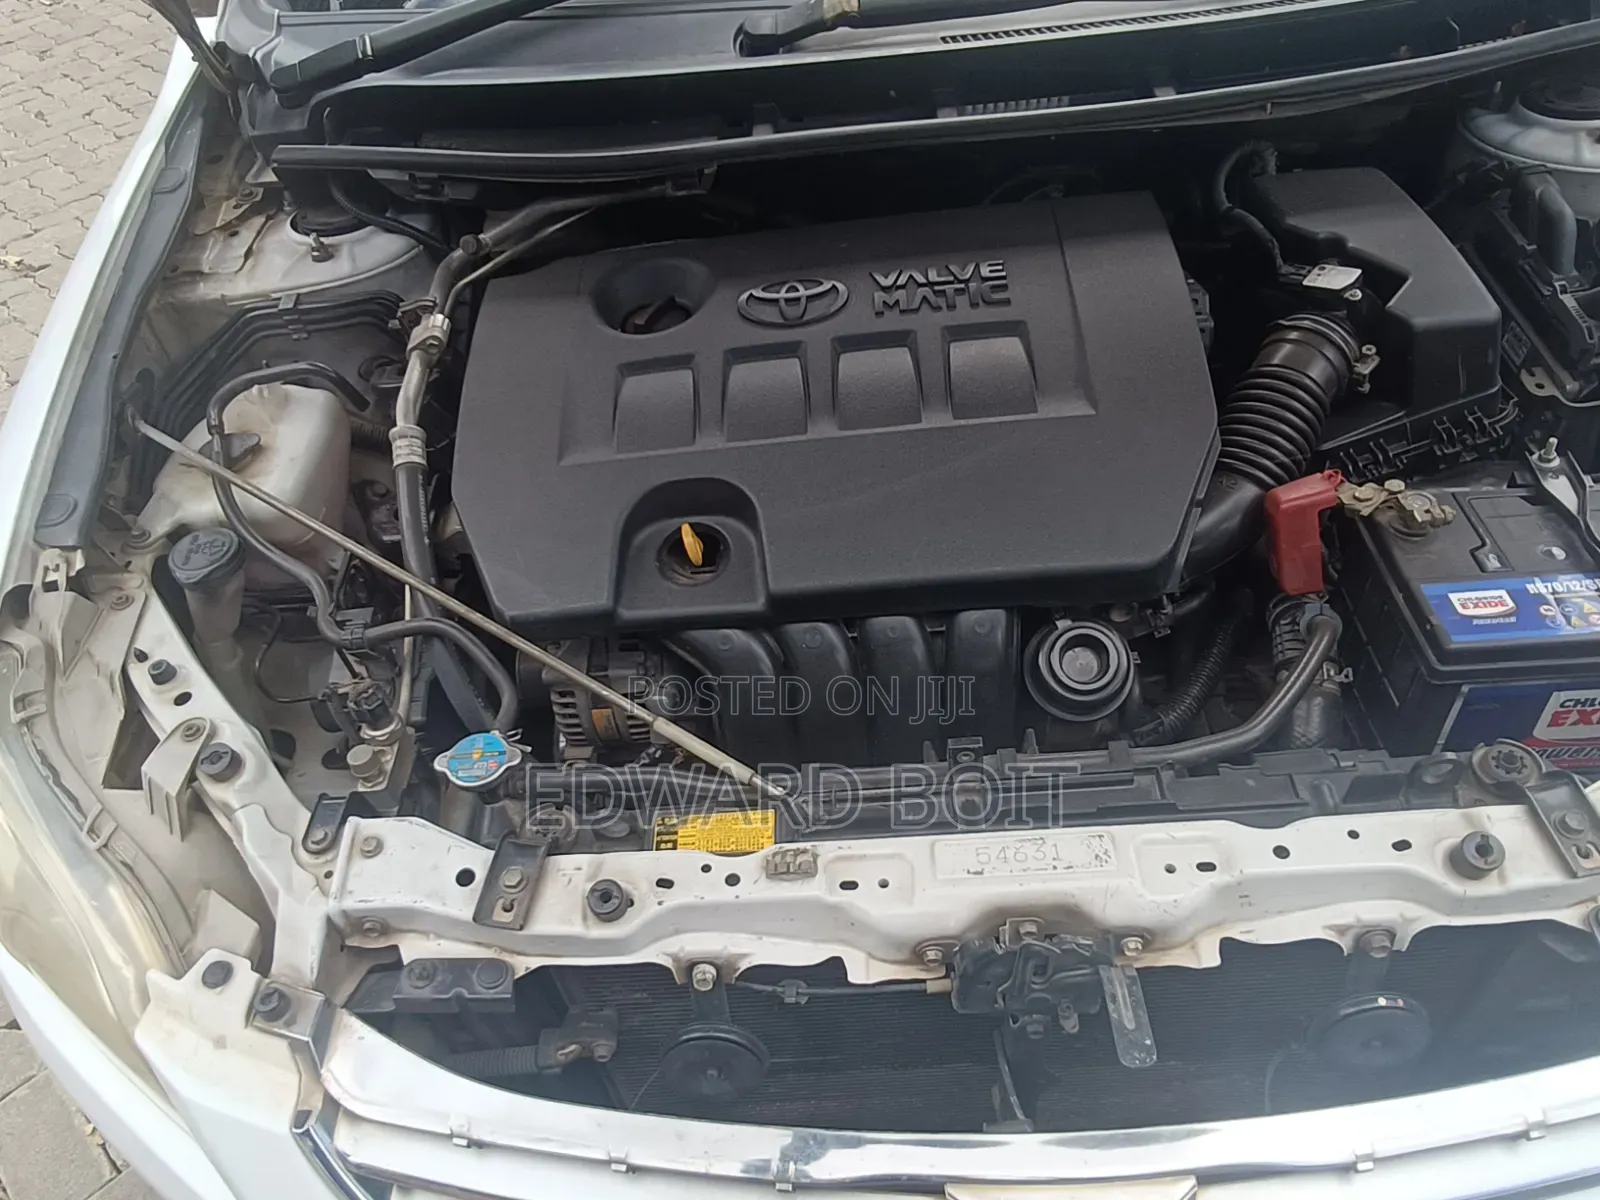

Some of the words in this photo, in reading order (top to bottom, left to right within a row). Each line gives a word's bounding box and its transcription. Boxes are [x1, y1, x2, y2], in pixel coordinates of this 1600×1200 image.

[870, 260, 1007, 288] VALVE
[873, 280, 1010, 316] MATIC
[1459, 600, 1510, 610] EXIDE
[1546, 709, 1600, 728] EX
